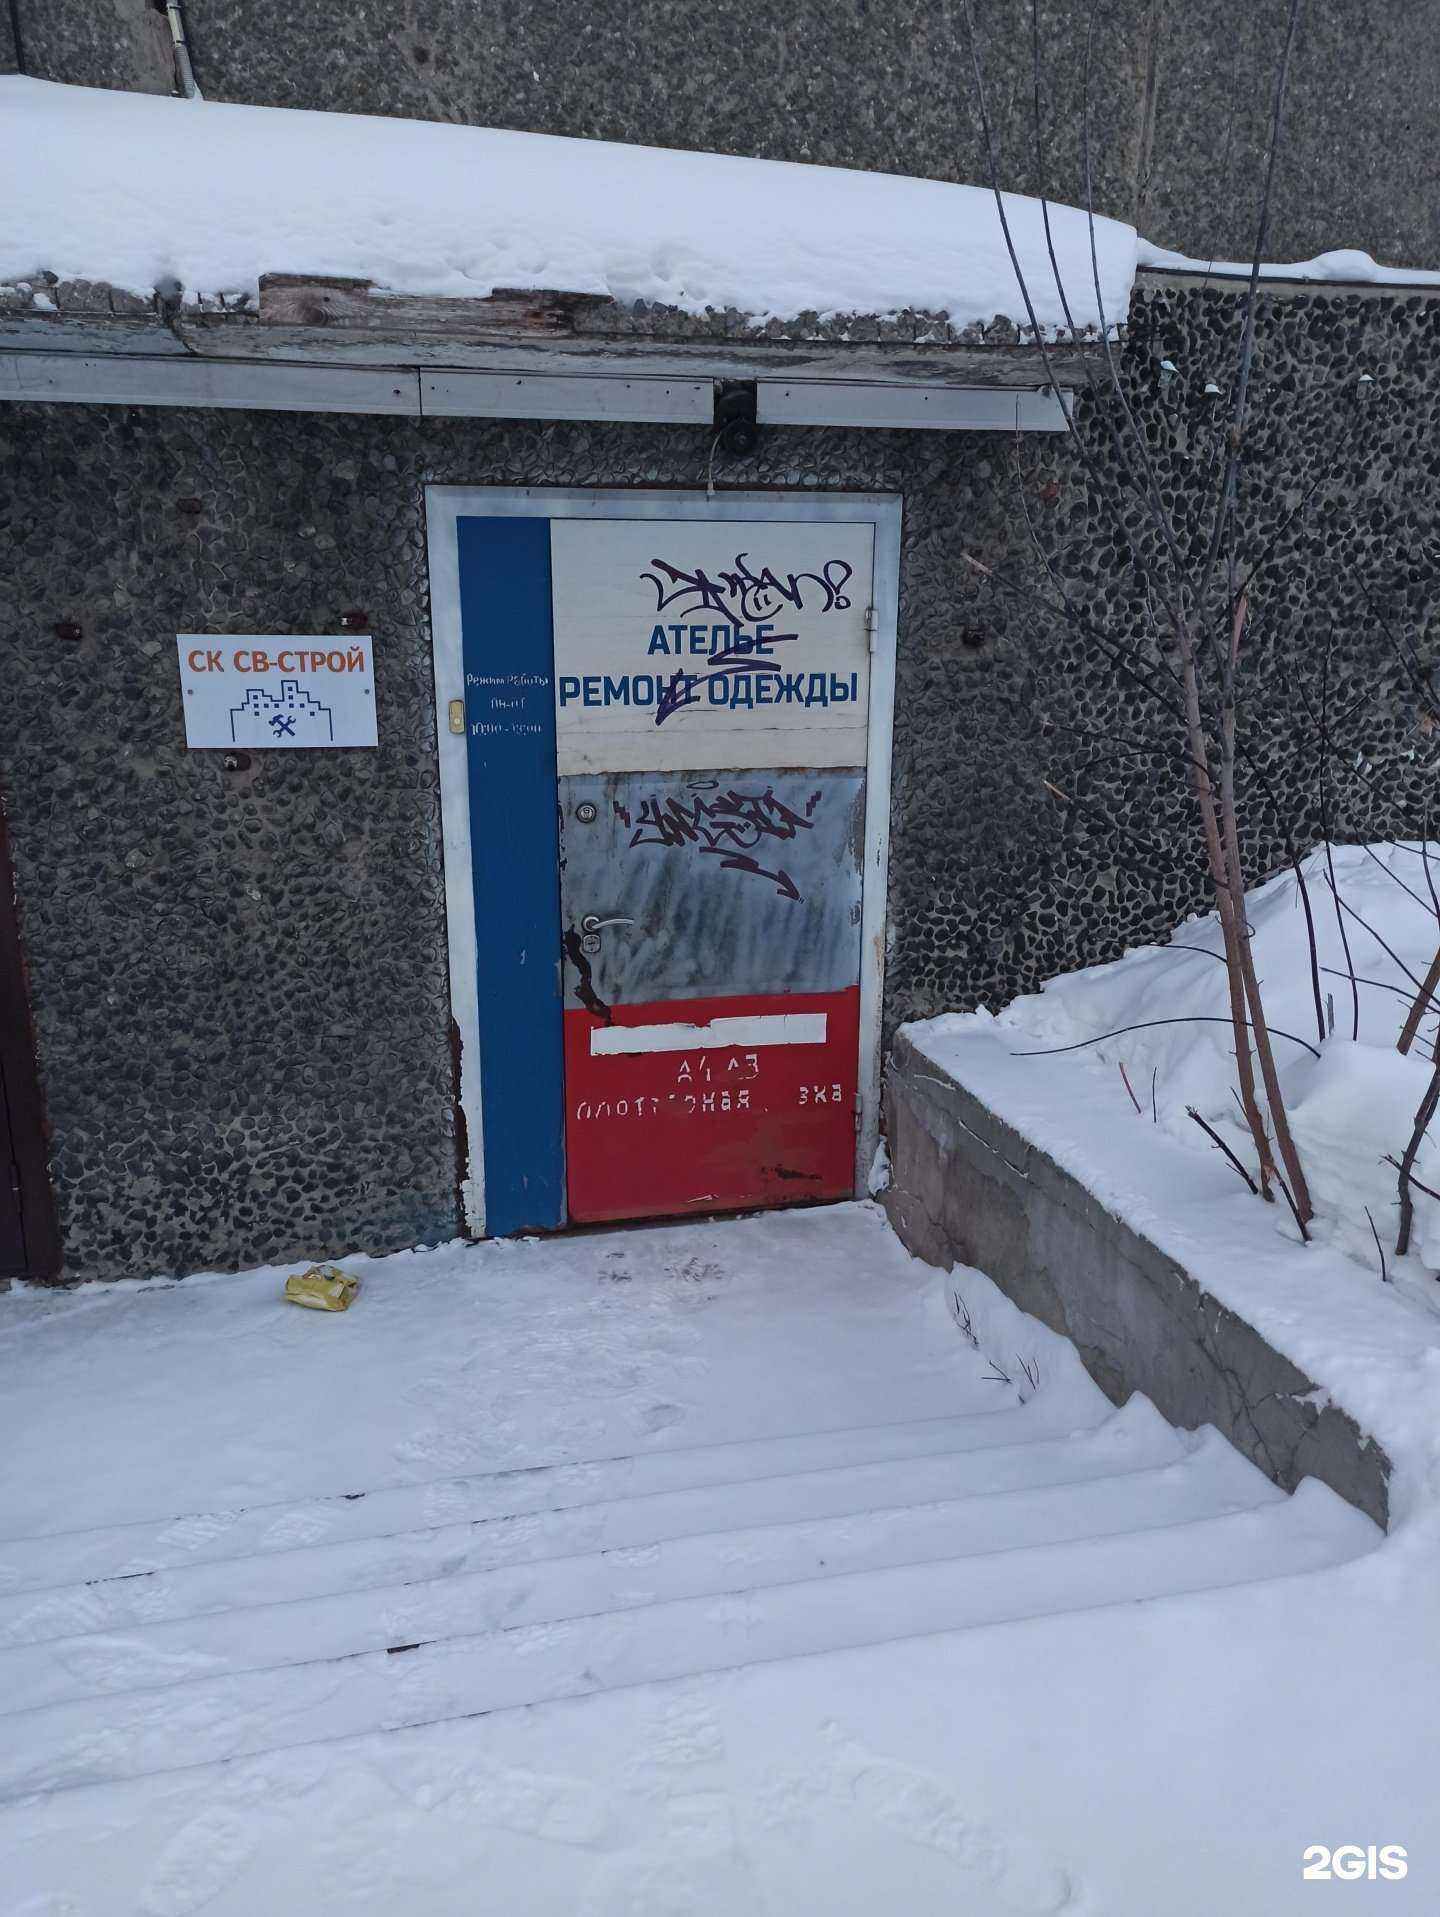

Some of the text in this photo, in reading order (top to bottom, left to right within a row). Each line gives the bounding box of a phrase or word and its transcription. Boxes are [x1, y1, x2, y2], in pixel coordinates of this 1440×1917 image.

[647, 624, 774, 655] АТЕЛЬЕ
[187, 646, 365, 672] СК СВ-СТРОЙ
[559, 672, 858, 709] РЕМОНТ ОДЕЖДЫ
